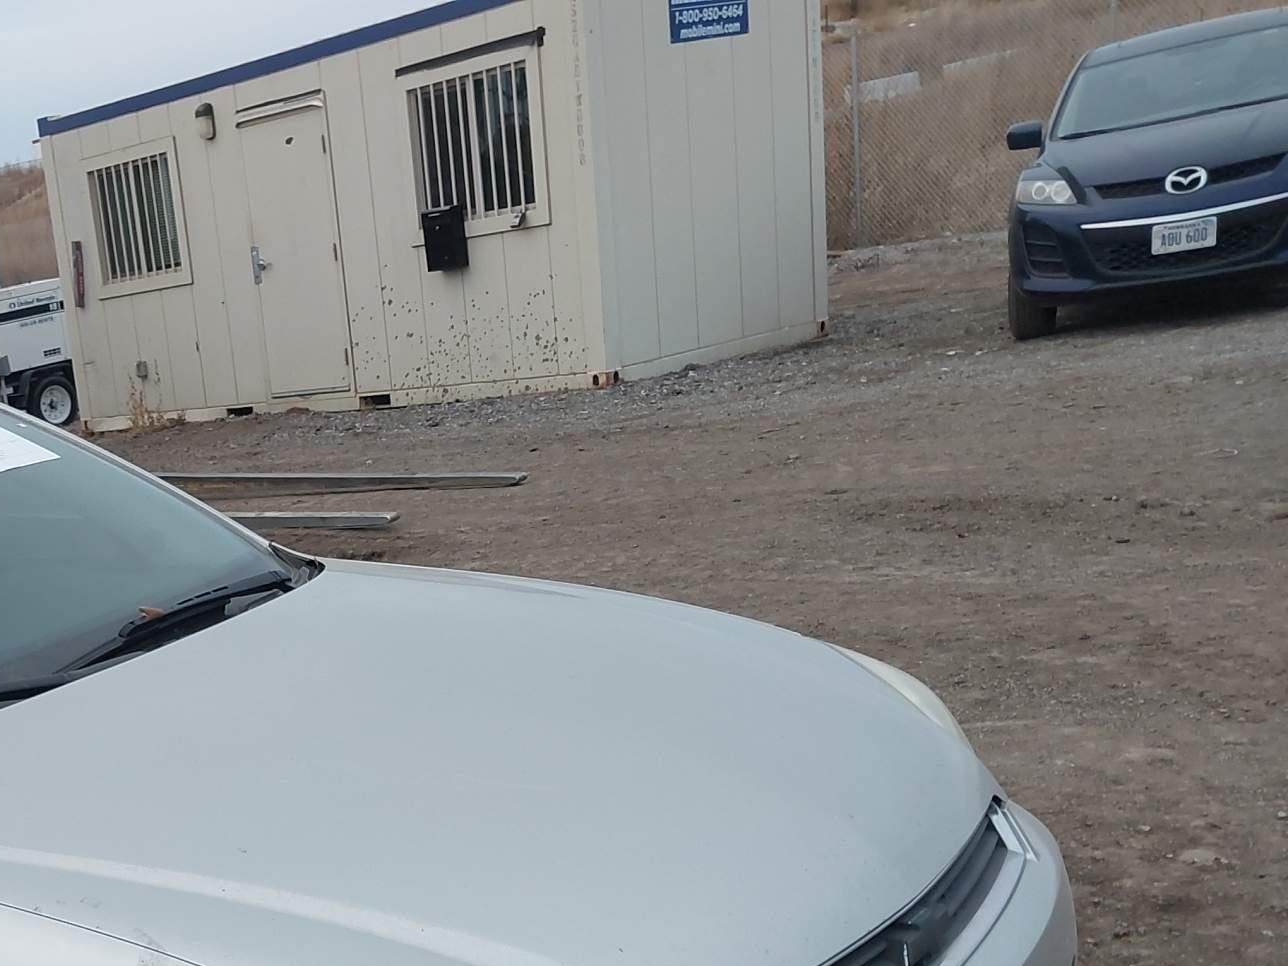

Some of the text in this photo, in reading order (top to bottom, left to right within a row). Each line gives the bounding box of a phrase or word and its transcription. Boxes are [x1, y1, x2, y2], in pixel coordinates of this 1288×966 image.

[675, 4, 743, 24] 1-800-950-6464
[680, 22, 741, 39] mobilemini.com
[1185, 227, 1208, 244] 600
